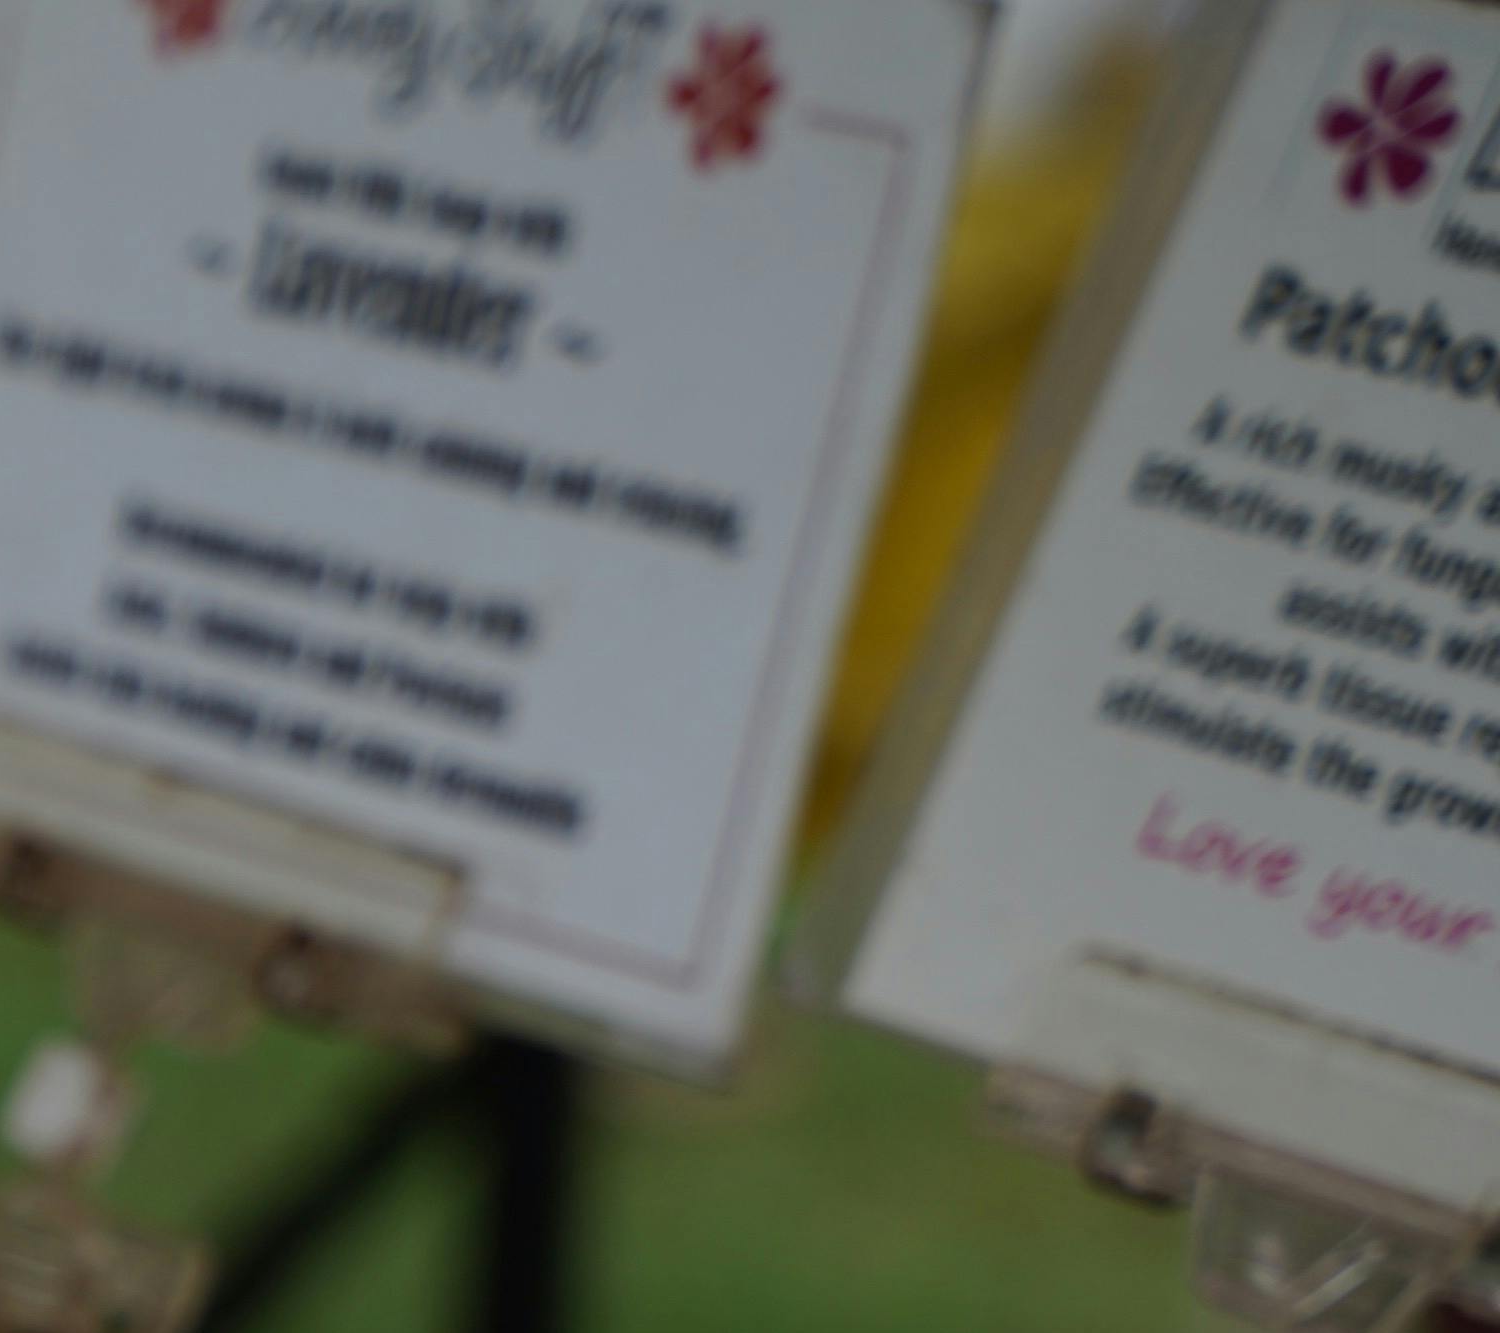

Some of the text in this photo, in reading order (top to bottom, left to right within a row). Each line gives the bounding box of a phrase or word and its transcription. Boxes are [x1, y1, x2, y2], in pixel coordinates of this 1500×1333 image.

[1239, 261, 1500, 396] Patcho
[1323, 504, 1381, 564] for
[1397, 526, 1500, 612] fung
[1438, 627, 1500, 689] wit
[1306, 739, 1378, 800] the
[1135, 792, 1494, 949] Love your
